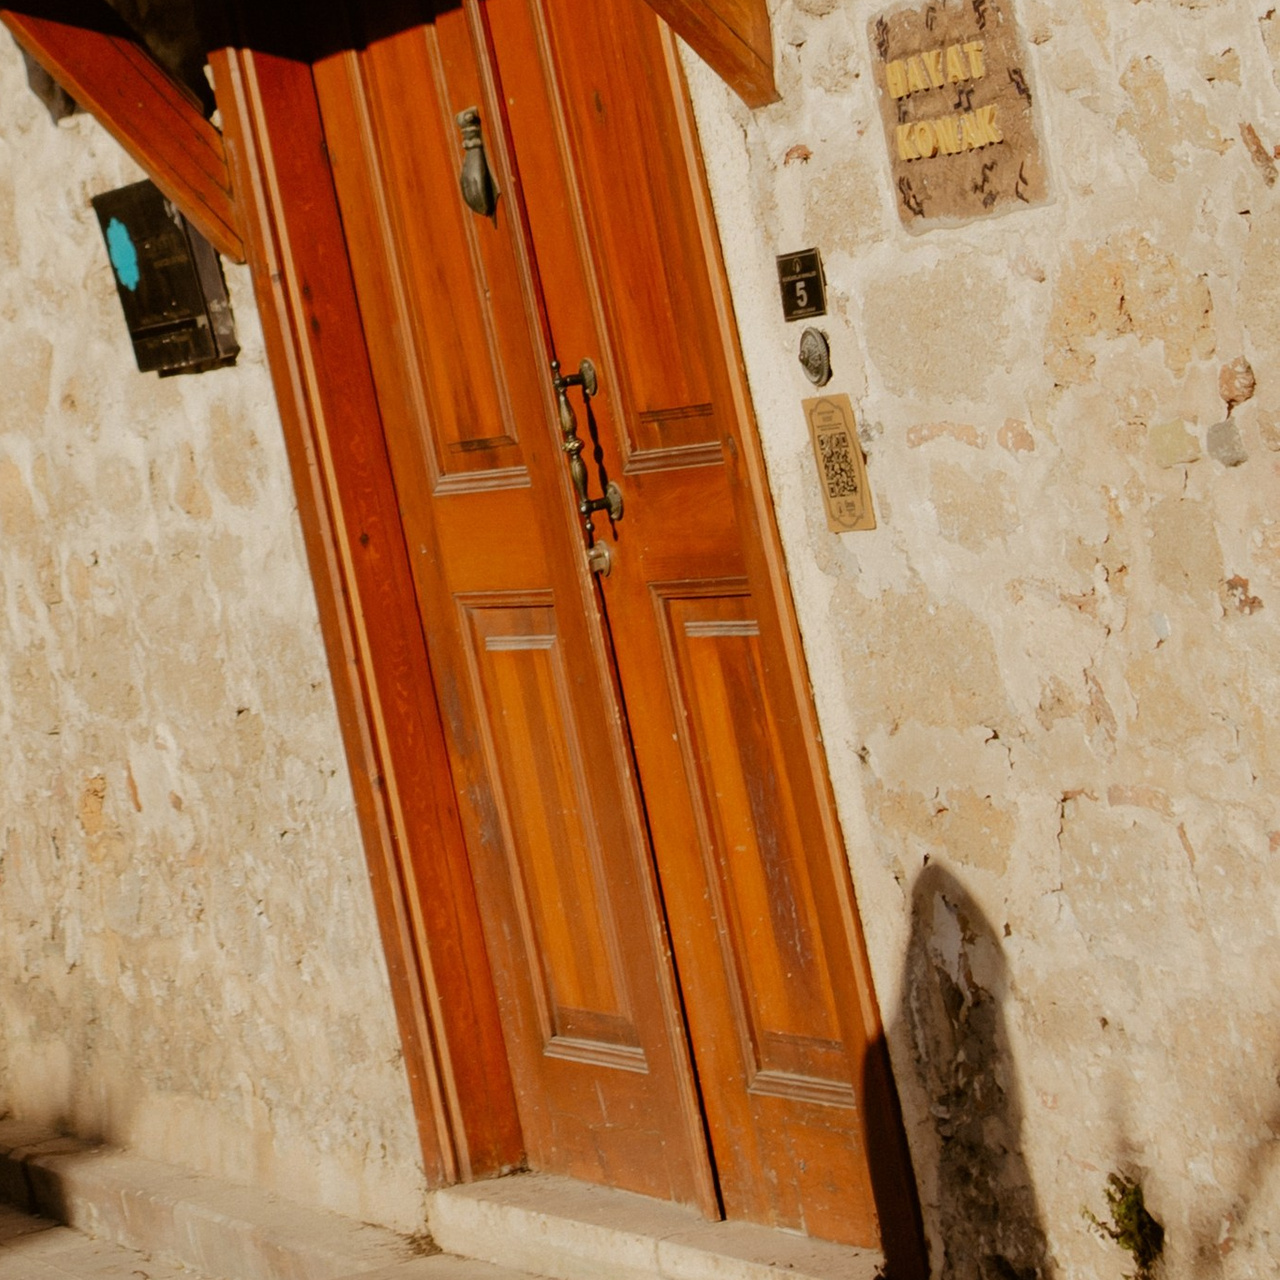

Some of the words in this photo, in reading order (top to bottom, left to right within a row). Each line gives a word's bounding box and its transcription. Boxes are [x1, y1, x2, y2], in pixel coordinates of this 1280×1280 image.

[885, 40, 986, 100] HAYAT
[895, 103, 1003, 161] KONAK
[795, 280, 809, 308] 5
